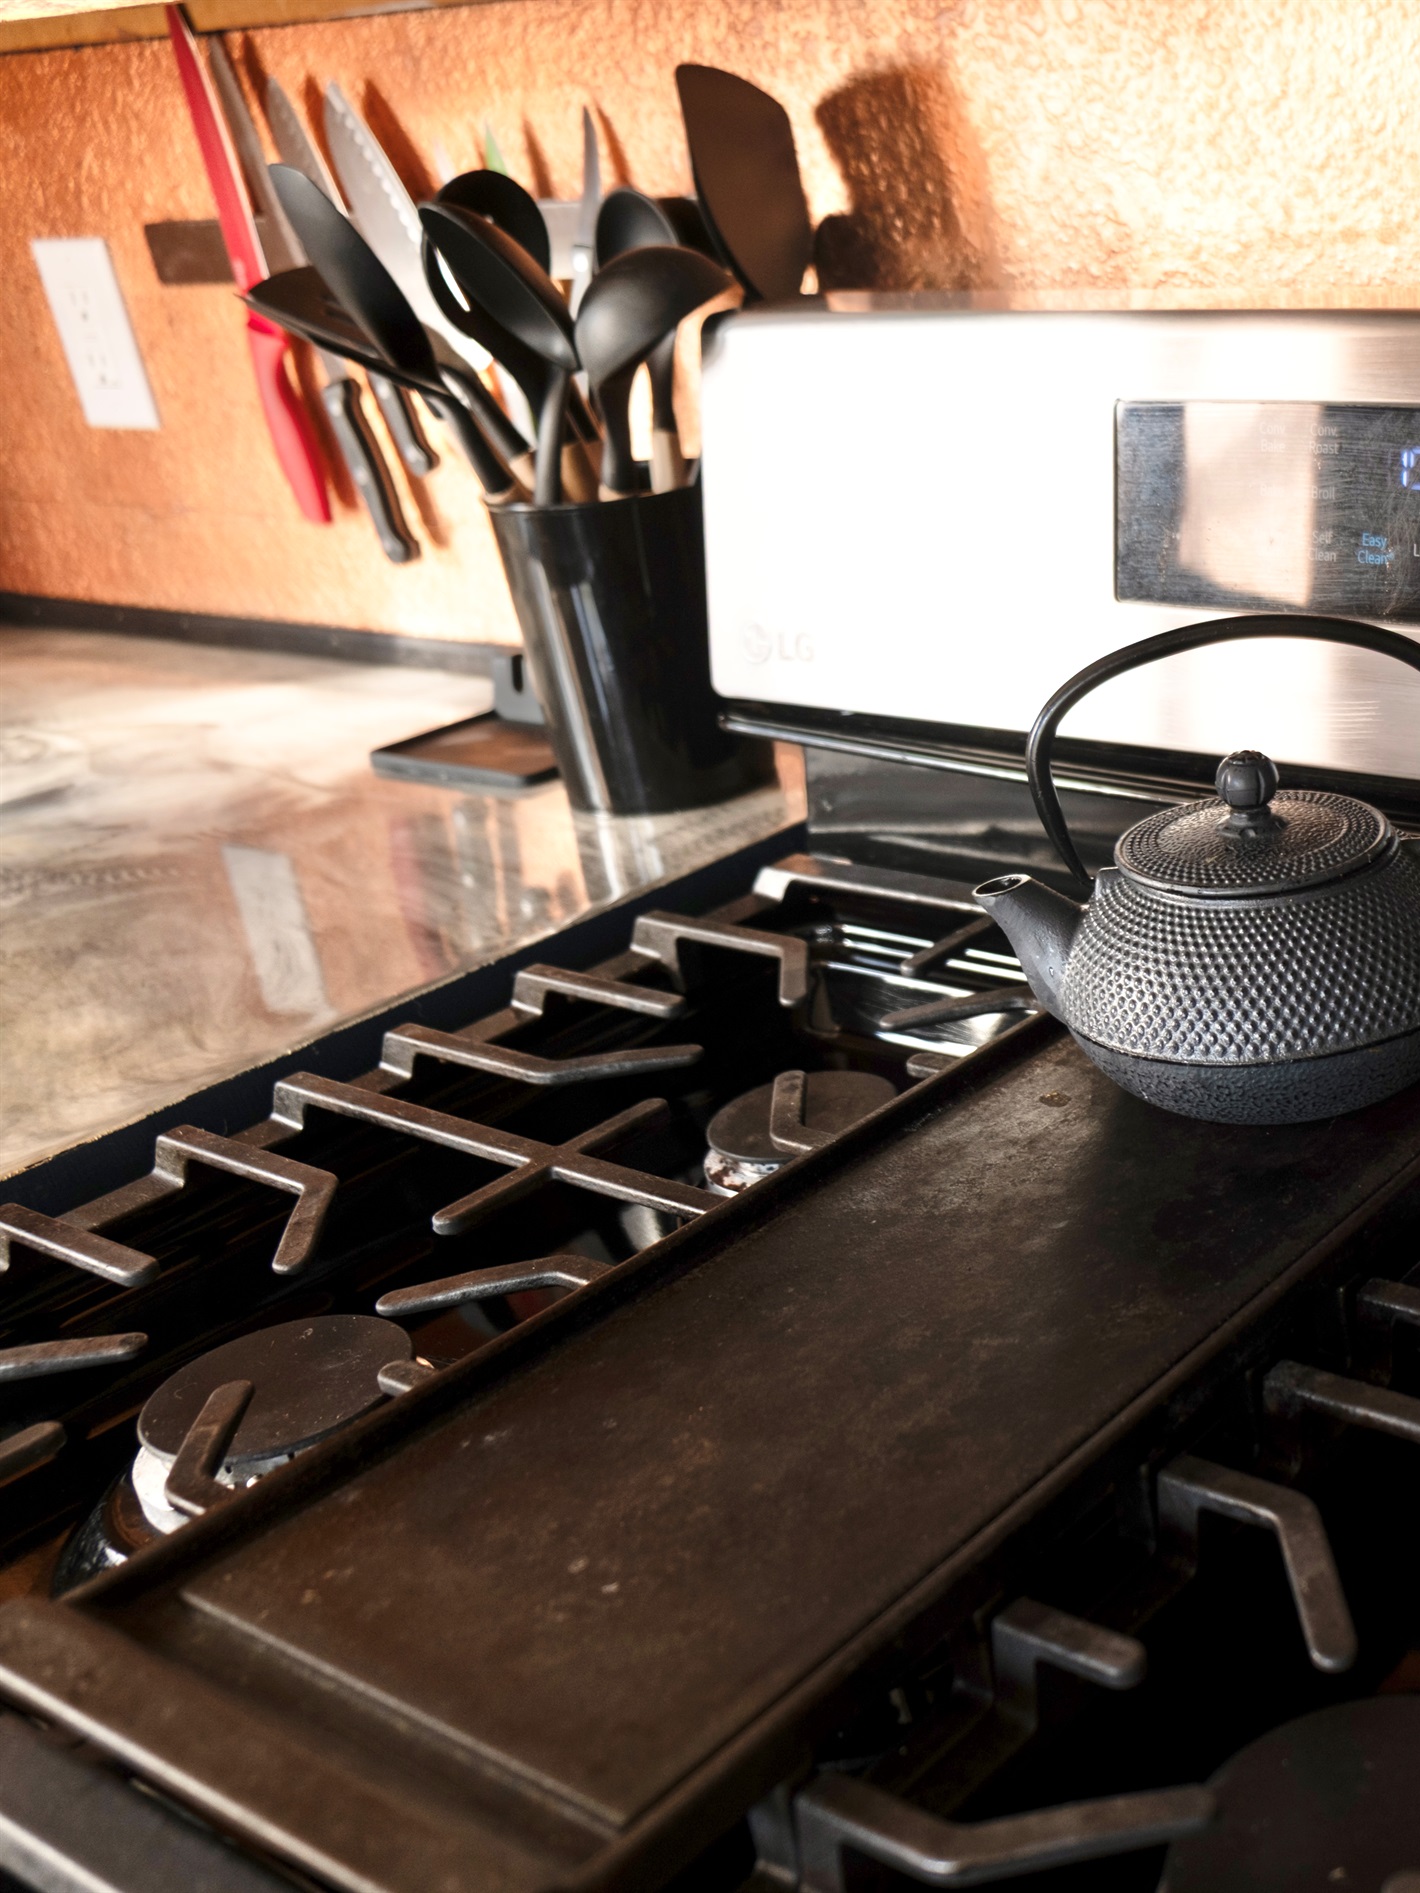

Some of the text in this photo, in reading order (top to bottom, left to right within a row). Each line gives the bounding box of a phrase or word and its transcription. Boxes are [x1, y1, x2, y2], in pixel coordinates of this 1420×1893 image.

[1259, 421, 1286, 435] Conv
[1310, 423, 1337, 437] Conv
[1260, 439, 1286, 453] Bake
[1308, 440, 1339, 455] Roast
[1311, 486, 1336, 500] Broil
[1312, 530, 1334, 545] Self
[1362, 532, 1387, 550] Easy
[1307, 547, 1337, 562] Clean
[777, 632, 816, 663] LG
